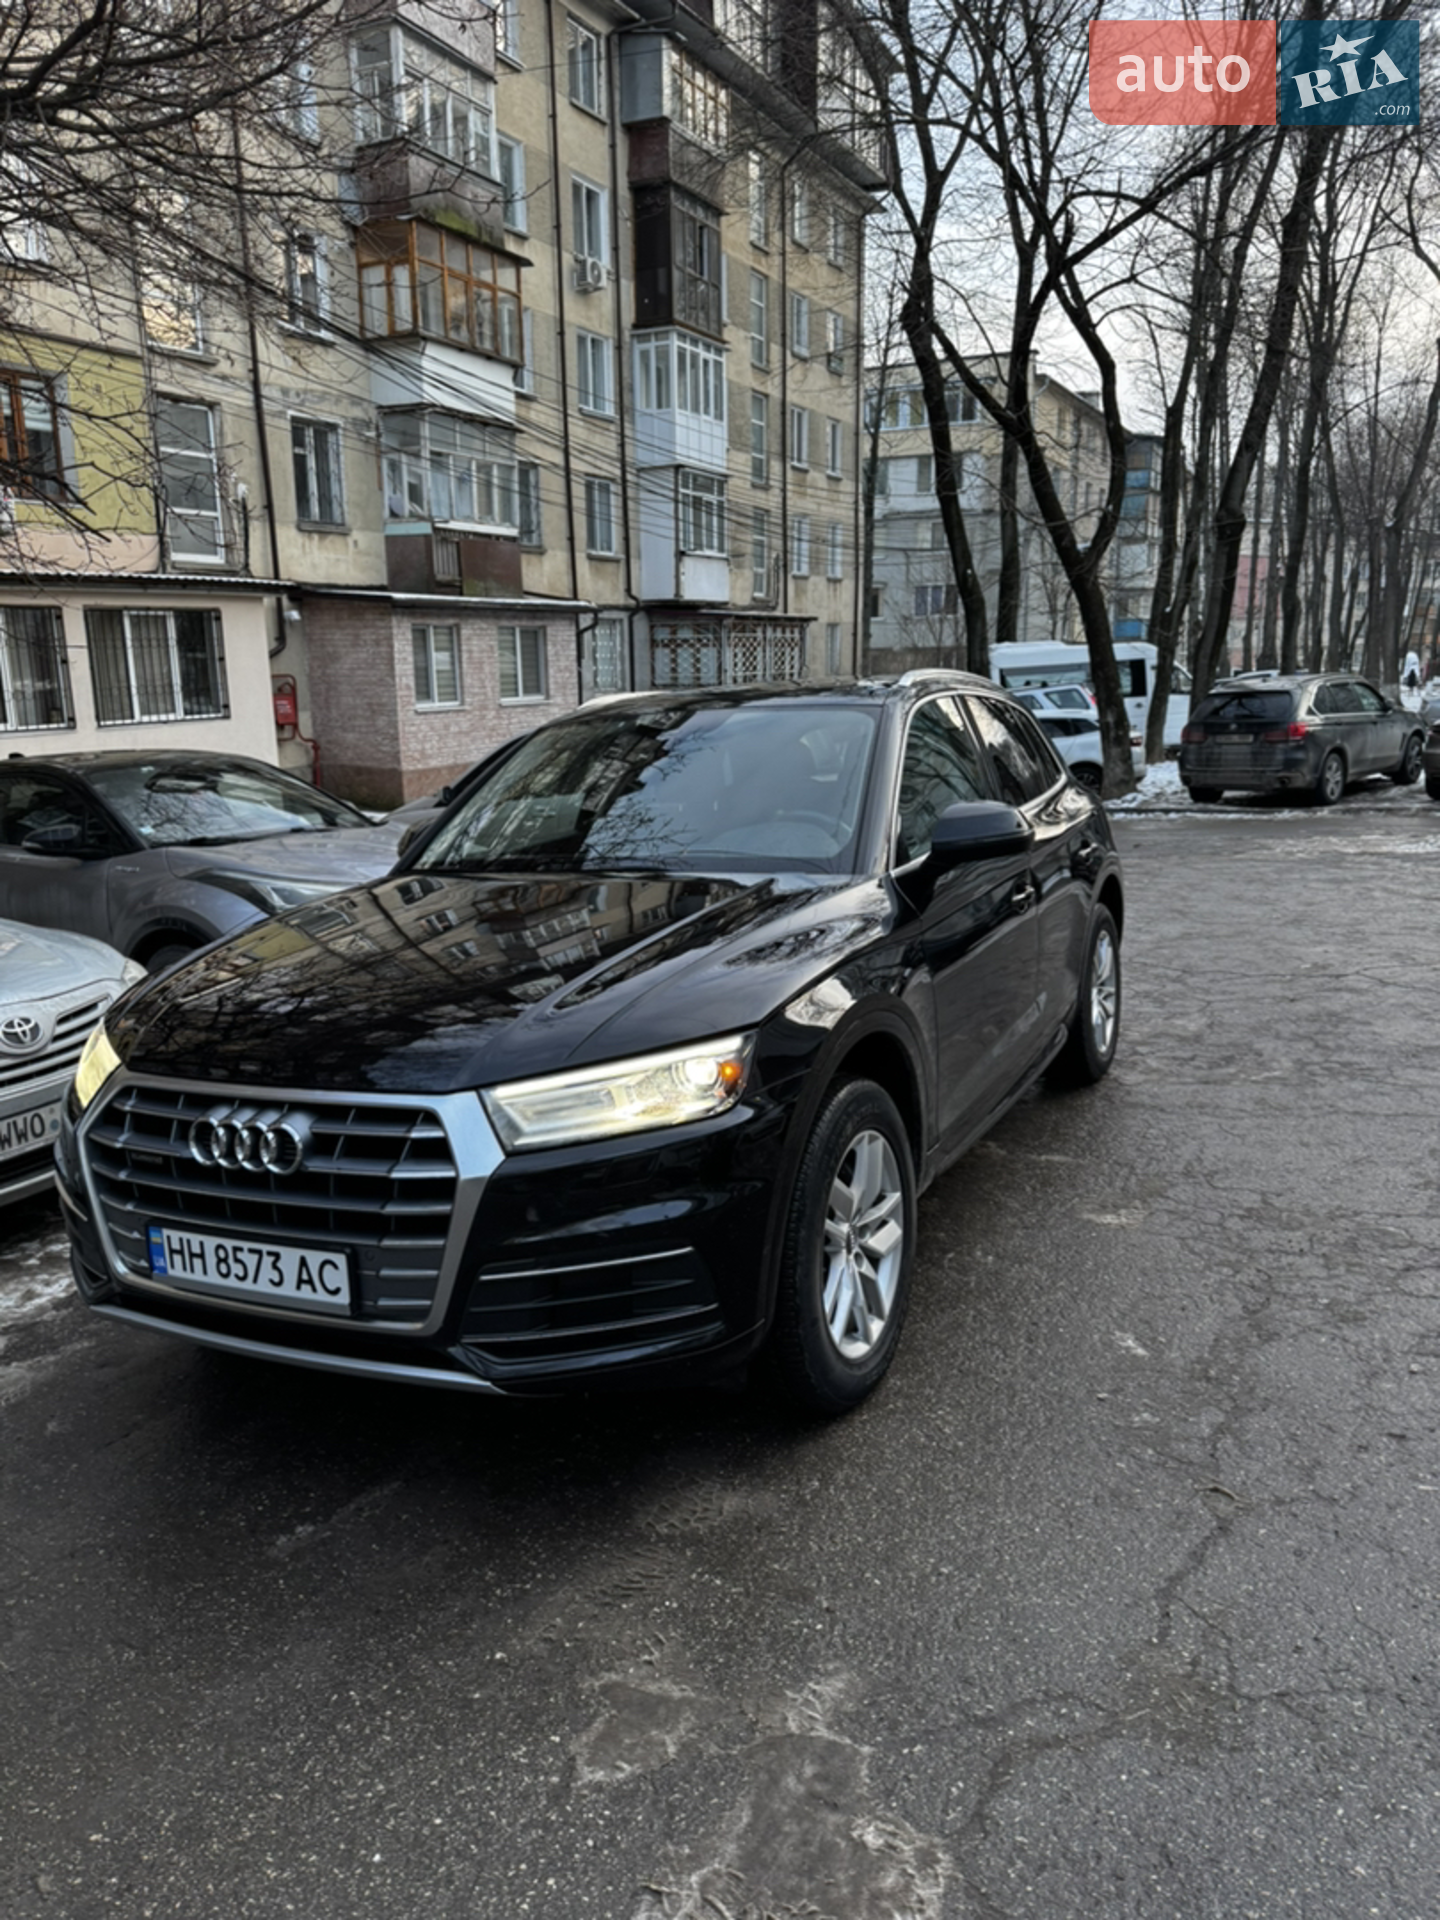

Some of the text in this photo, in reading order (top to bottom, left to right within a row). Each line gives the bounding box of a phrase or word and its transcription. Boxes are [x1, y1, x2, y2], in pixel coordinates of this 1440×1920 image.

[153, 1255, 166, 1268] UA
[166, 1234, 342, 1296] HH 8573 AC
